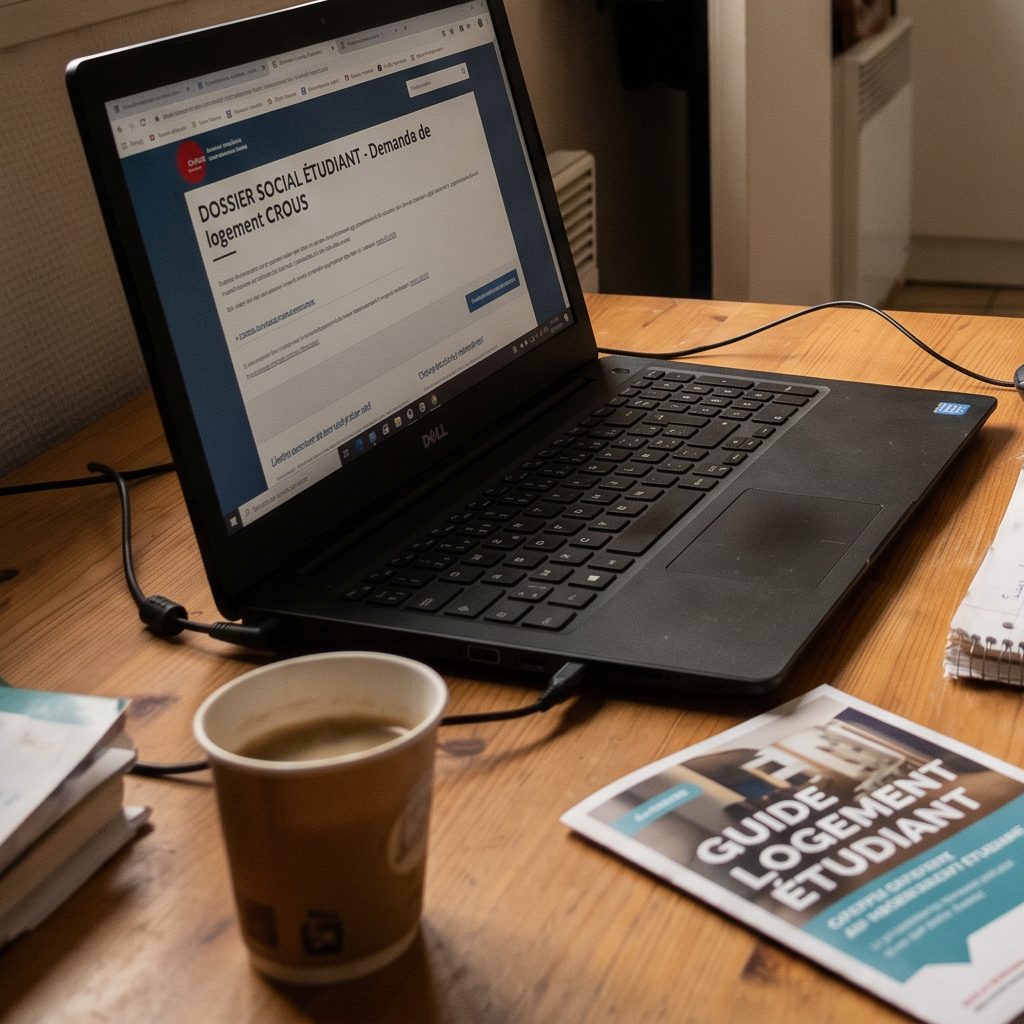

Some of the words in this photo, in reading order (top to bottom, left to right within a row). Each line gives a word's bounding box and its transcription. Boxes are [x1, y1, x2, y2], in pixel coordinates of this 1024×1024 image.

[197, 188, 256, 223] DOSSIER
[256, 170, 304, 201] SOCIAL
[302, 147, 362, 184] ÉTUDIANT
[418, 123, 432, 140] de
[205, 212, 265, 248] logement
[265, 193, 309, 224] CROUS
[421, 423, 449, 449] DELL
[696, 785, 839, 864] GUIDE
[729, 758, 958, 891] LOGEMENT
[770, 786, 981, 912] ÉTUDIANT
